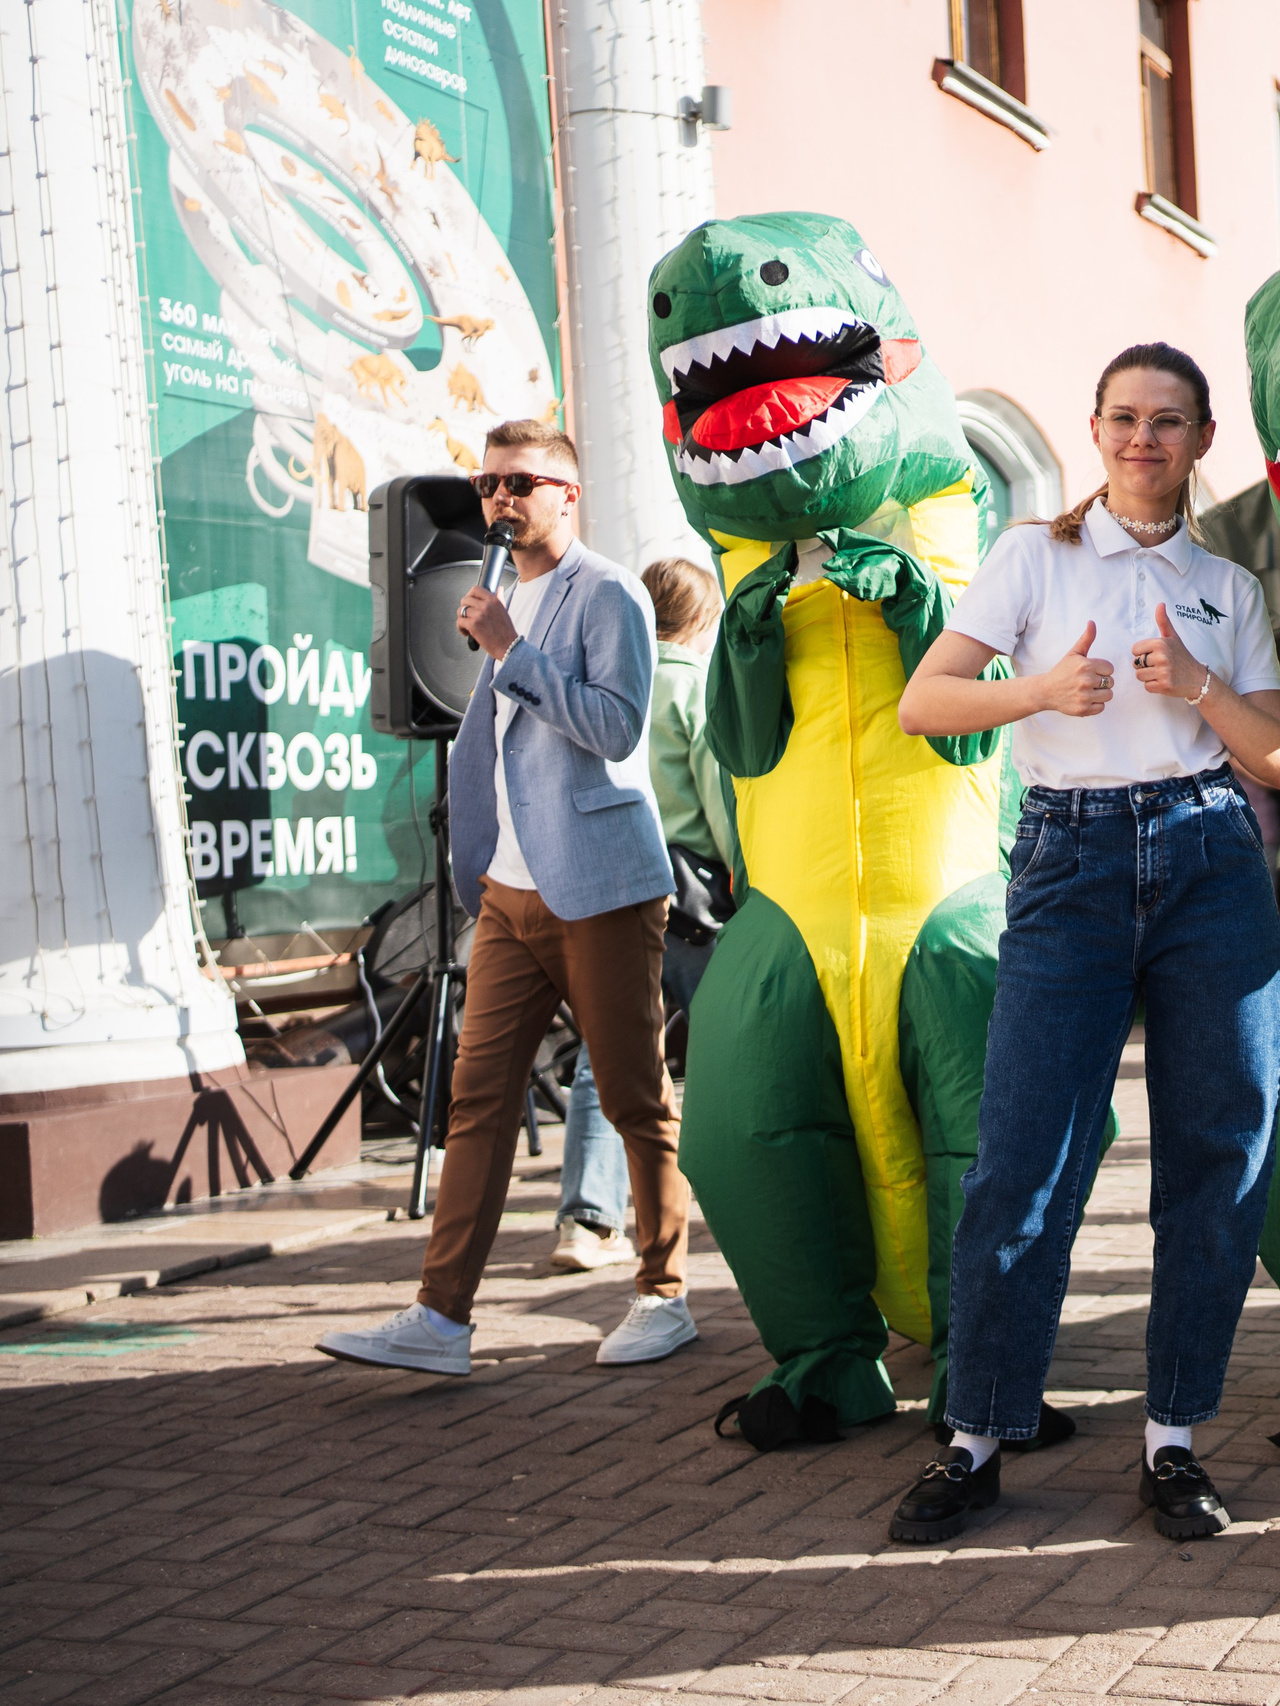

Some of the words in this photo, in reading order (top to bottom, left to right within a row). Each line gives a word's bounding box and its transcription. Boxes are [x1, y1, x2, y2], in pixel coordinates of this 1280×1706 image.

[381, 0, 457, 39] подлинные
[382, 18, 439, 56] остатки
[384, 45, 468, 93] динозавров
[158, 296, 198, 328] 360
[161, 331, 223, 362] самый
[162, 360, 213, 388] уголь
[215, 373, 239, 394] на
[242, 379, 309, 408] планете
[1175, 604, 1202, 615] ОТДЕЛ
[1176, 611, 1213, 625] ПРИРОДЫ
[181, 632, 372, 717] ПРОЙДИ
[185, 729, 378, 791] СКВОЗЬ
[191, 815, 358, 879] ВРЕМЯ!
